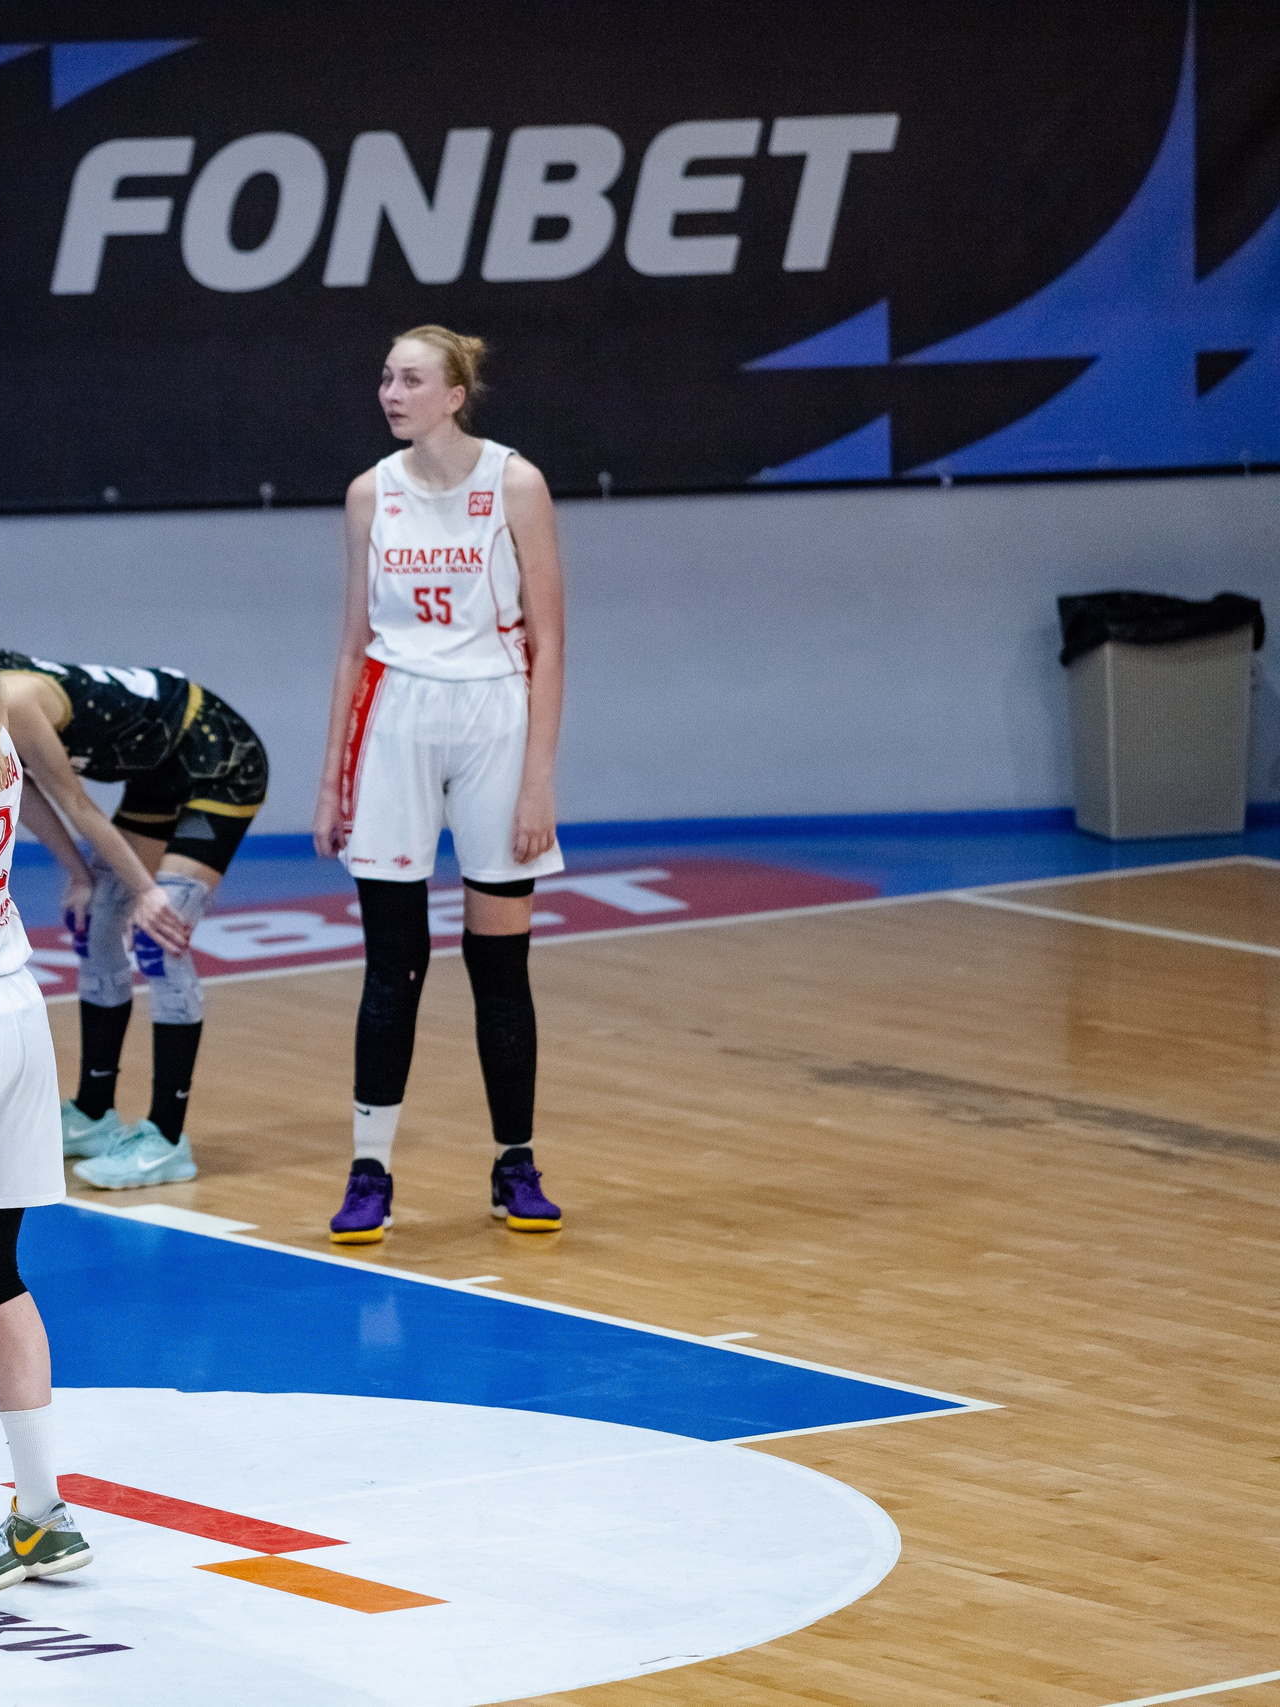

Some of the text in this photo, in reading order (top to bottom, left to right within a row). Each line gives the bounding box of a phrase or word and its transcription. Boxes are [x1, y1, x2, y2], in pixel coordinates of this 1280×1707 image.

[51, 112, 900, 296] FONBET
[384, 547, 483, 566] СПАРТАК
[413, 587, 452, 626] 55
